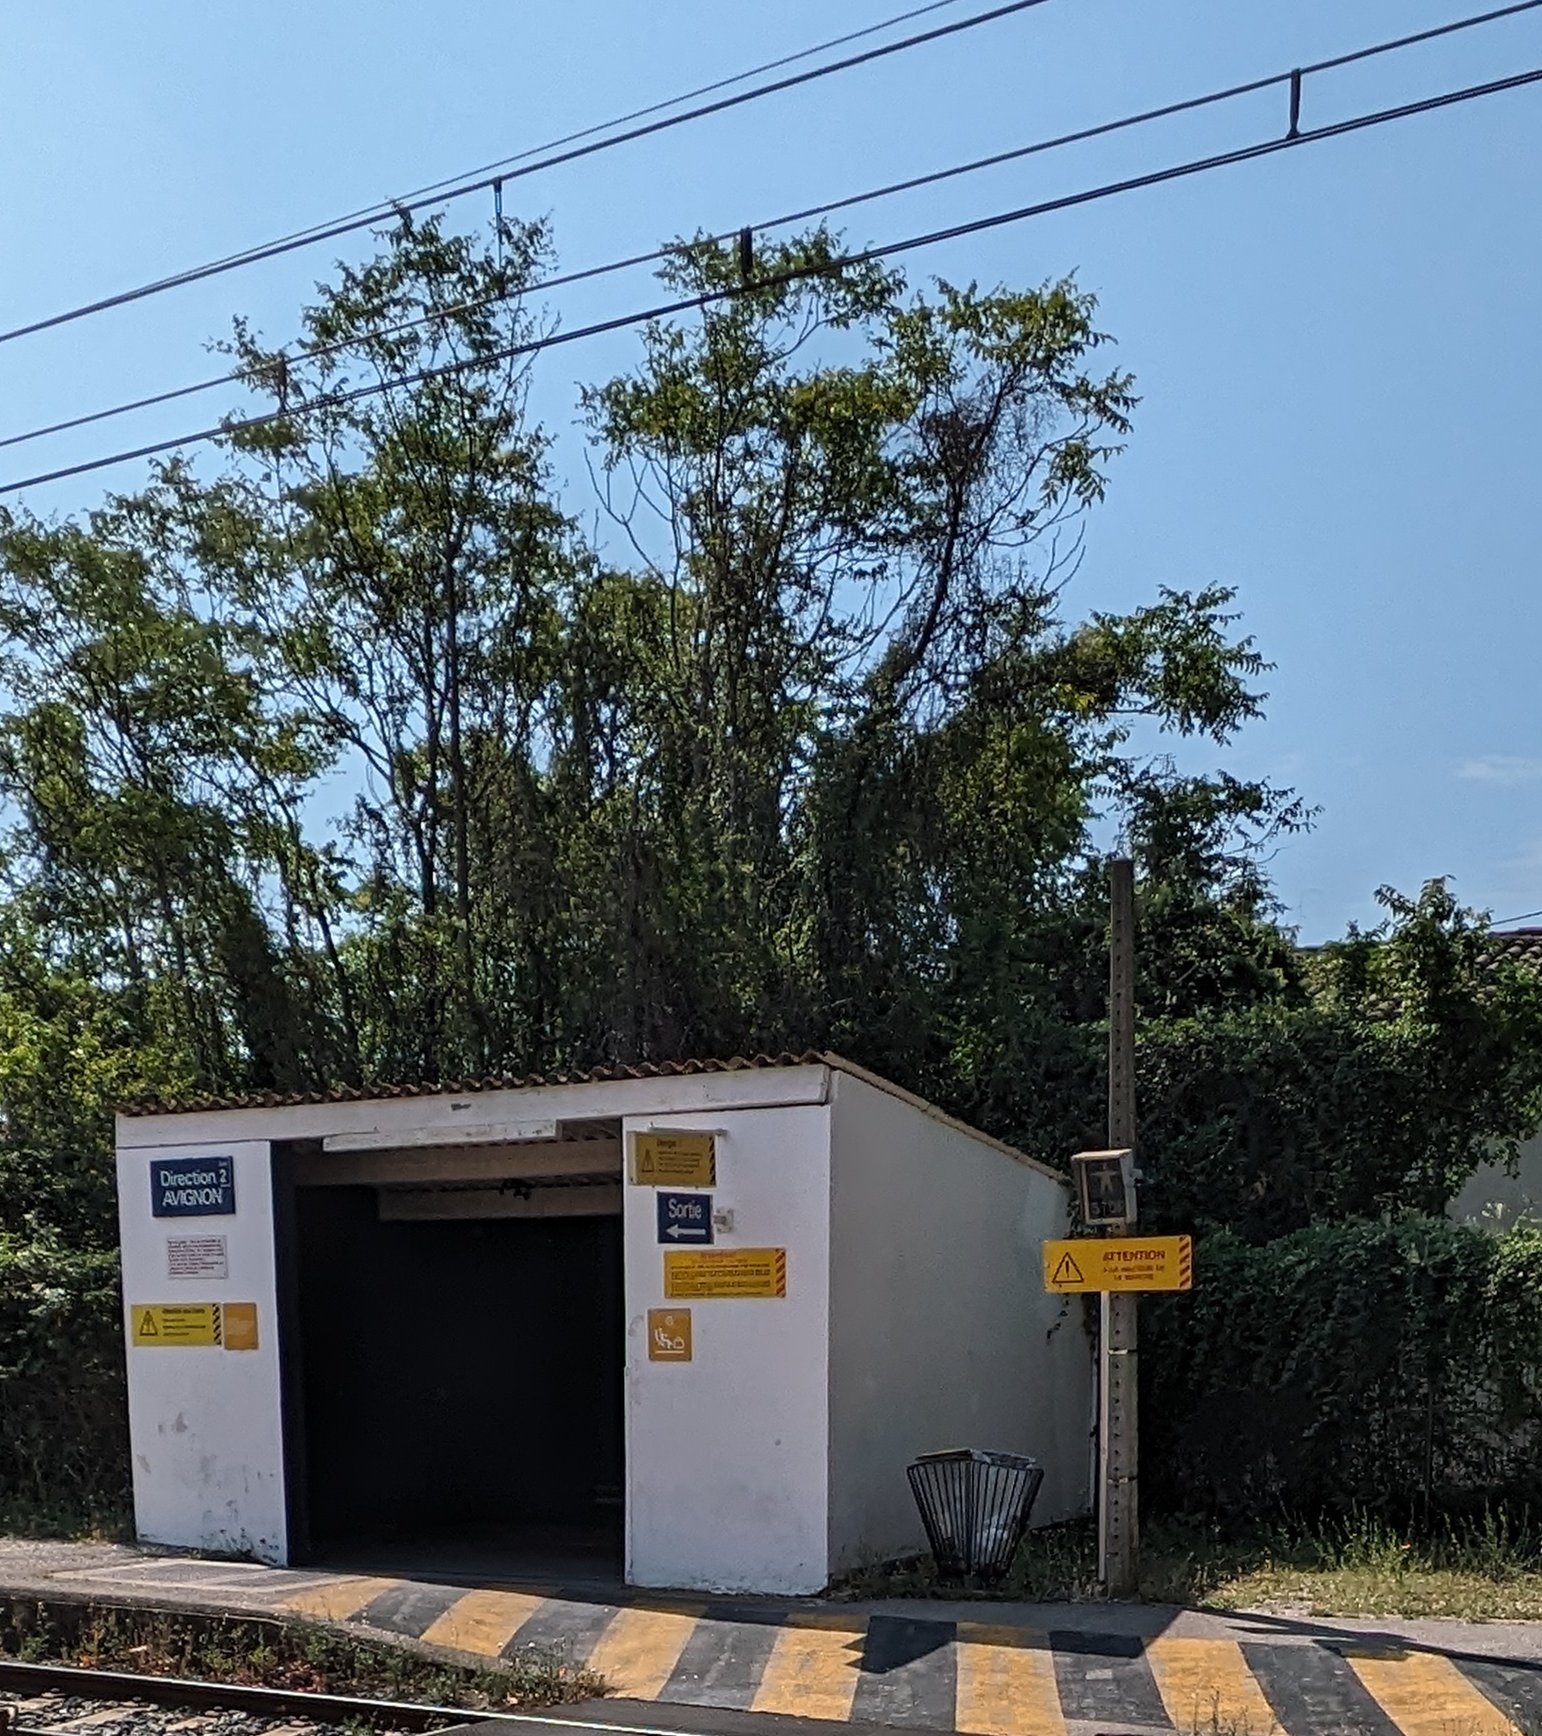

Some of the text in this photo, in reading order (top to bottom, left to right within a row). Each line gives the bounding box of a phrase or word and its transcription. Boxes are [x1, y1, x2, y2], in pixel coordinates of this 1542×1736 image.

[160, 1168, 217, 1187] Direction
[162, 1187, 223, 1207] AVIGNON
[668, 1197, 703, 1220] Sortie
[1102, 1249, 1166, 1262] ATTENTION
